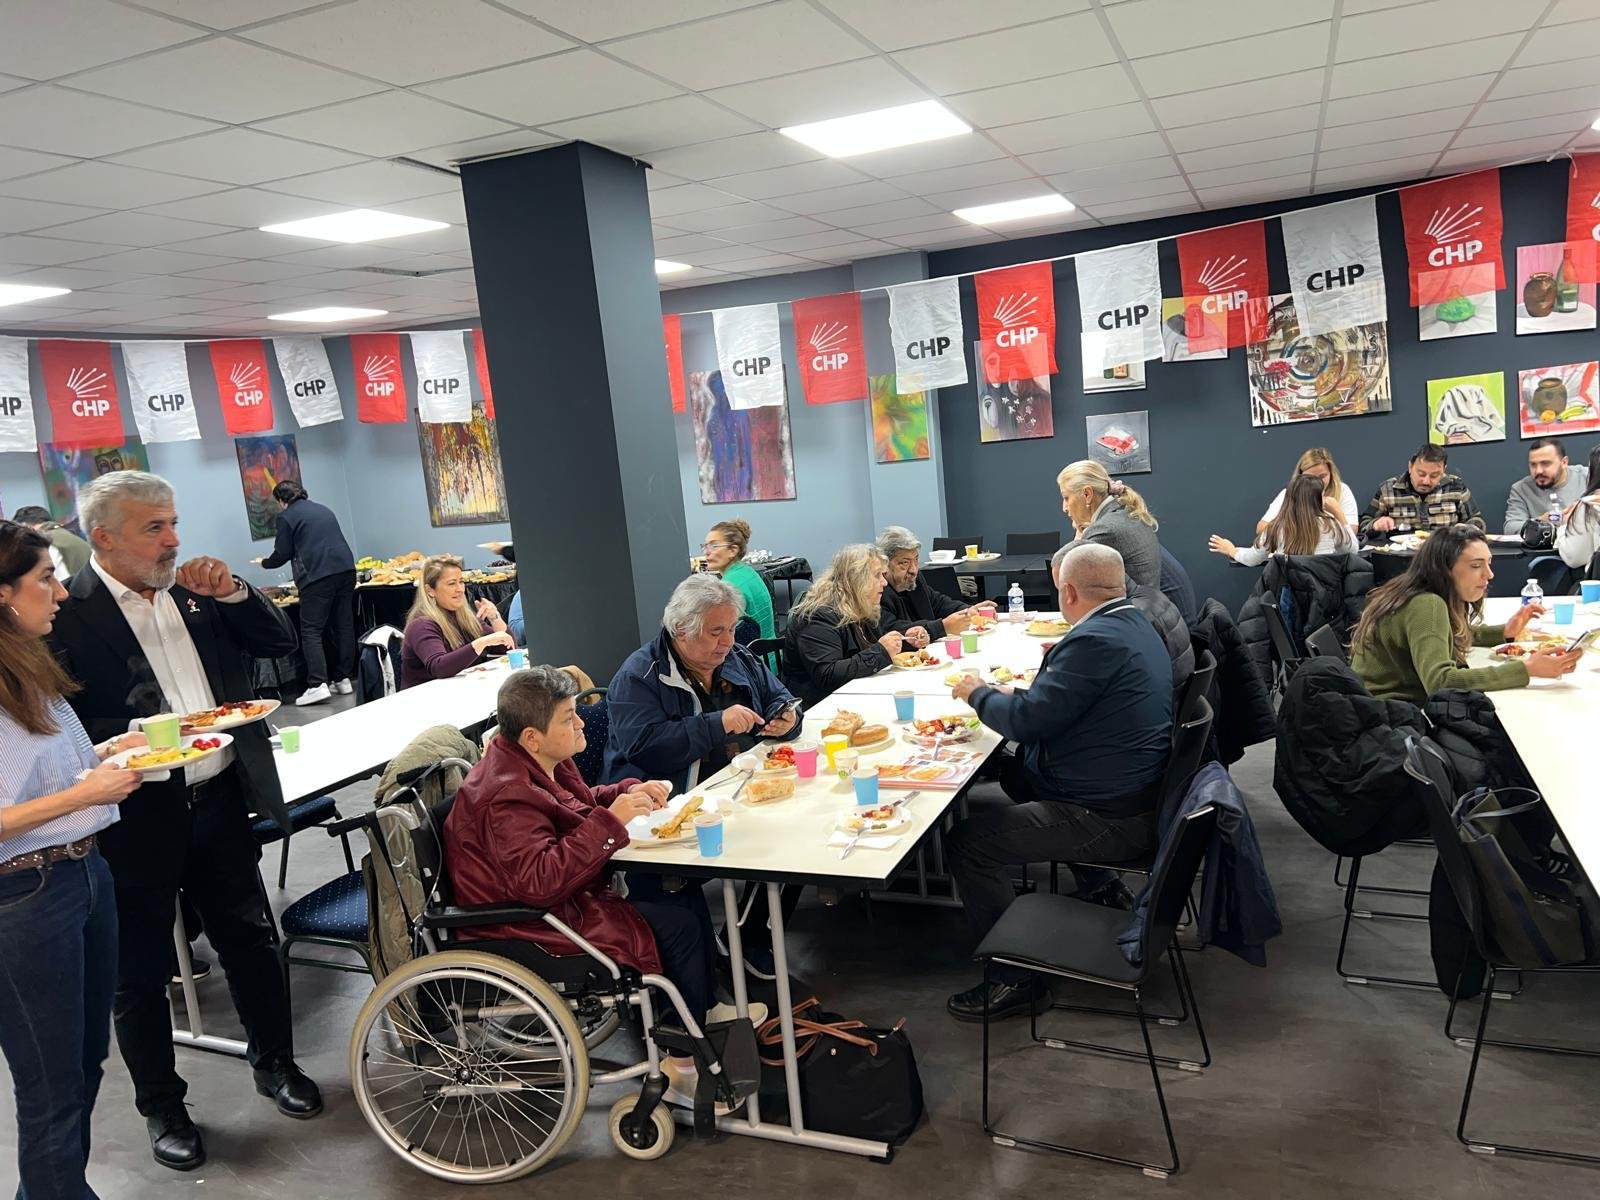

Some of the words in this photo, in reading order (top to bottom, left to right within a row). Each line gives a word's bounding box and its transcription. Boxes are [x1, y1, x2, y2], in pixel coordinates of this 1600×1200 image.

[1428, 239, 1483, 267] CHP
[1307, 263, 1365, 293] CHP
[1201, 290, 1249, 314] CHP
[1098, 304, 1149, 331] CHP
[996, 326, 1039, 347] CHP
[906, 336, 950, 360] CHP
[732, 356, 771, 377] CHP
[812, 352, 848, 372] CHP
[294, 379, 326, 398] CHP
[365, 381, 395, 397] CHP
[423, 378, 459, 395] CHP
[0, 396, 22, 416] HP
[72, 399, 110, 417] CHP
[148, 394, 185, 412] CHP
[234, 390, 264, 407] CHP
